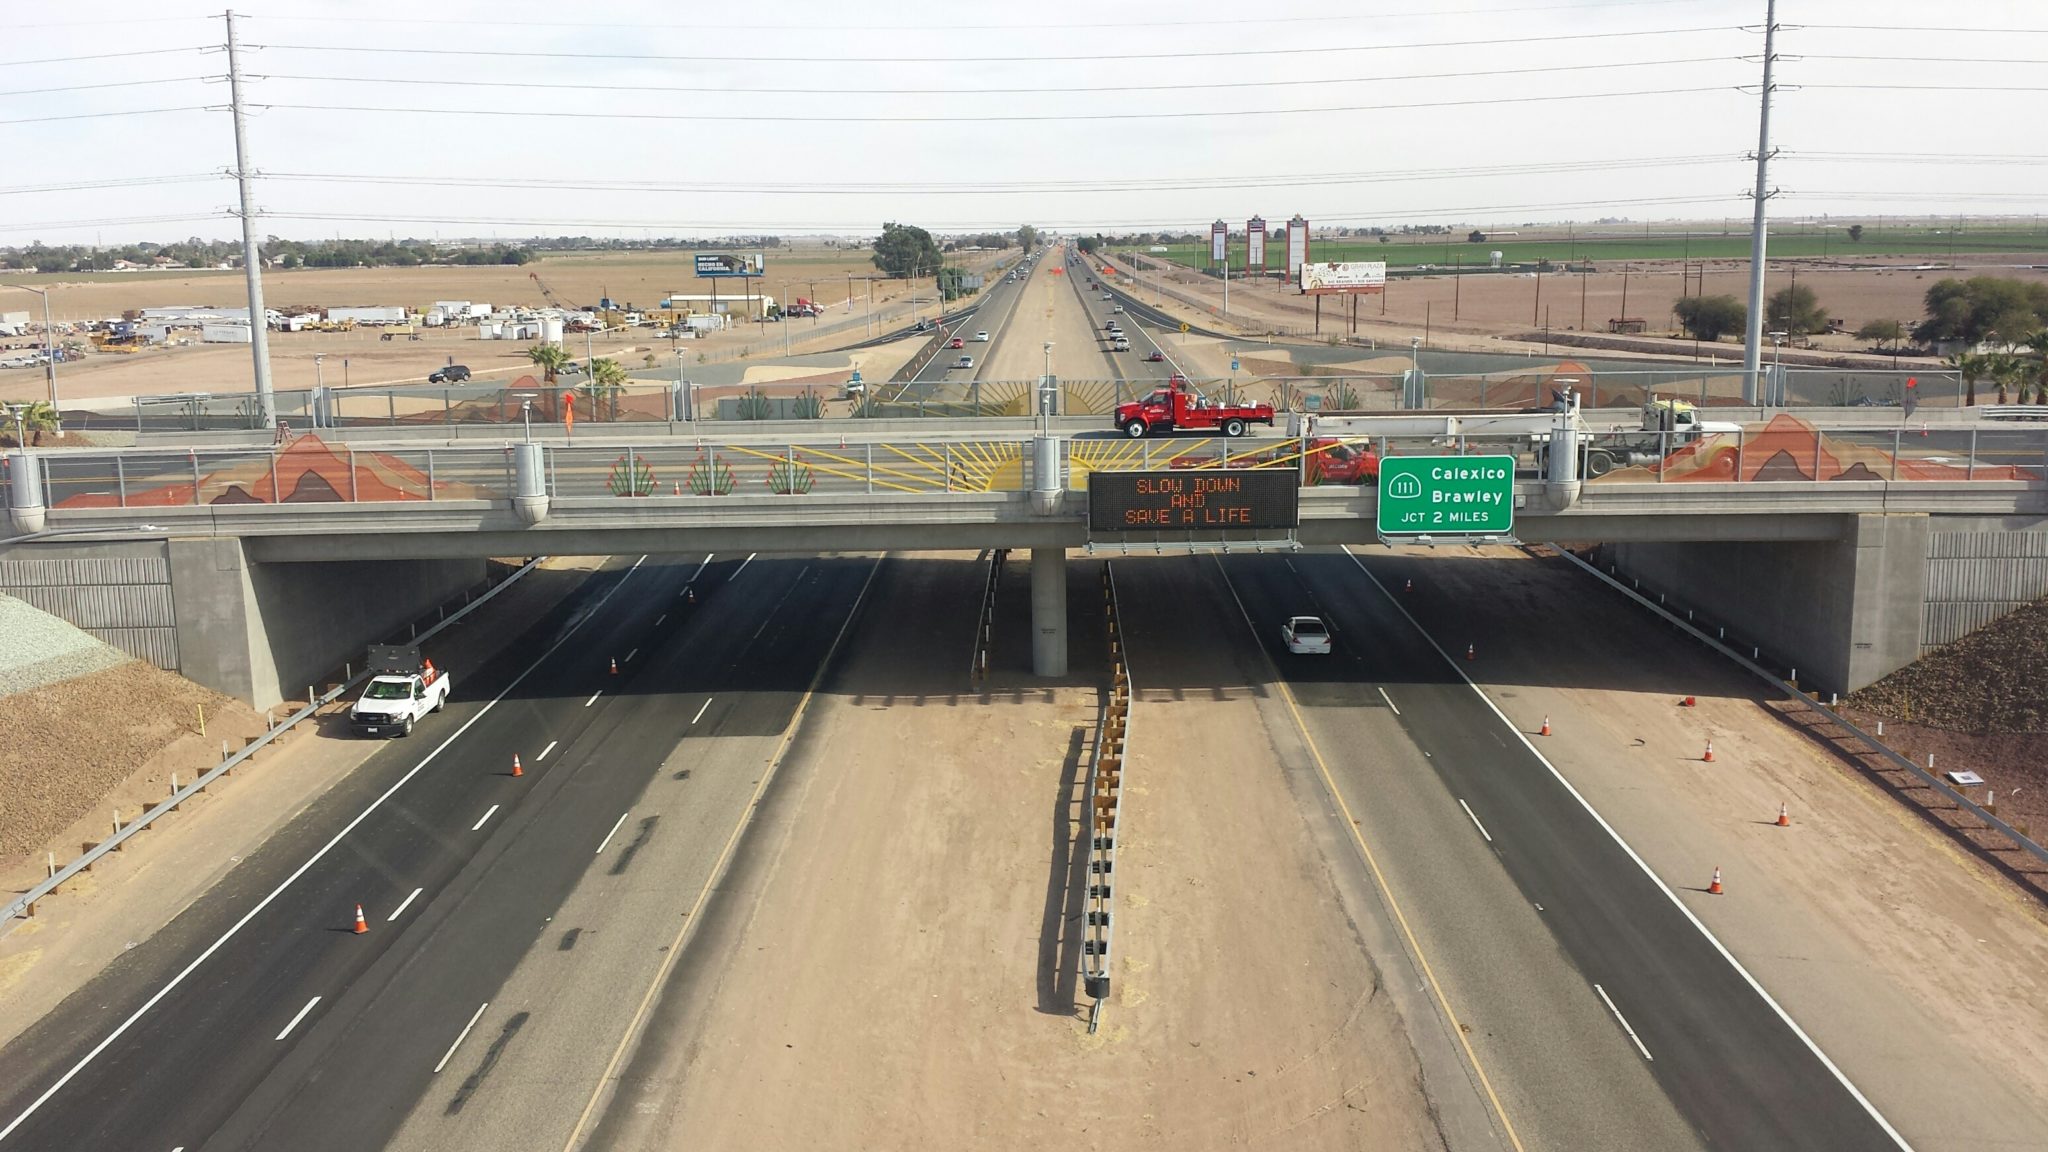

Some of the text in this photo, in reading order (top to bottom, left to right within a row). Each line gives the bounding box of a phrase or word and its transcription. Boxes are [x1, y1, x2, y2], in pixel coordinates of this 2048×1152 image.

[1431, 467, 1506, 480] Calexico
[1136, 477, 1240, 494] SLOW DOWN
[1397, 482, 1413, 494] 111
[1171, 492, 1205, 508] AND
[1432, 490, 1503, 505] Brawley
[1125, 508, 1251, 524] SAVE A LIFE
[1401, 511, 1489, 523] JCT 2 MILES
